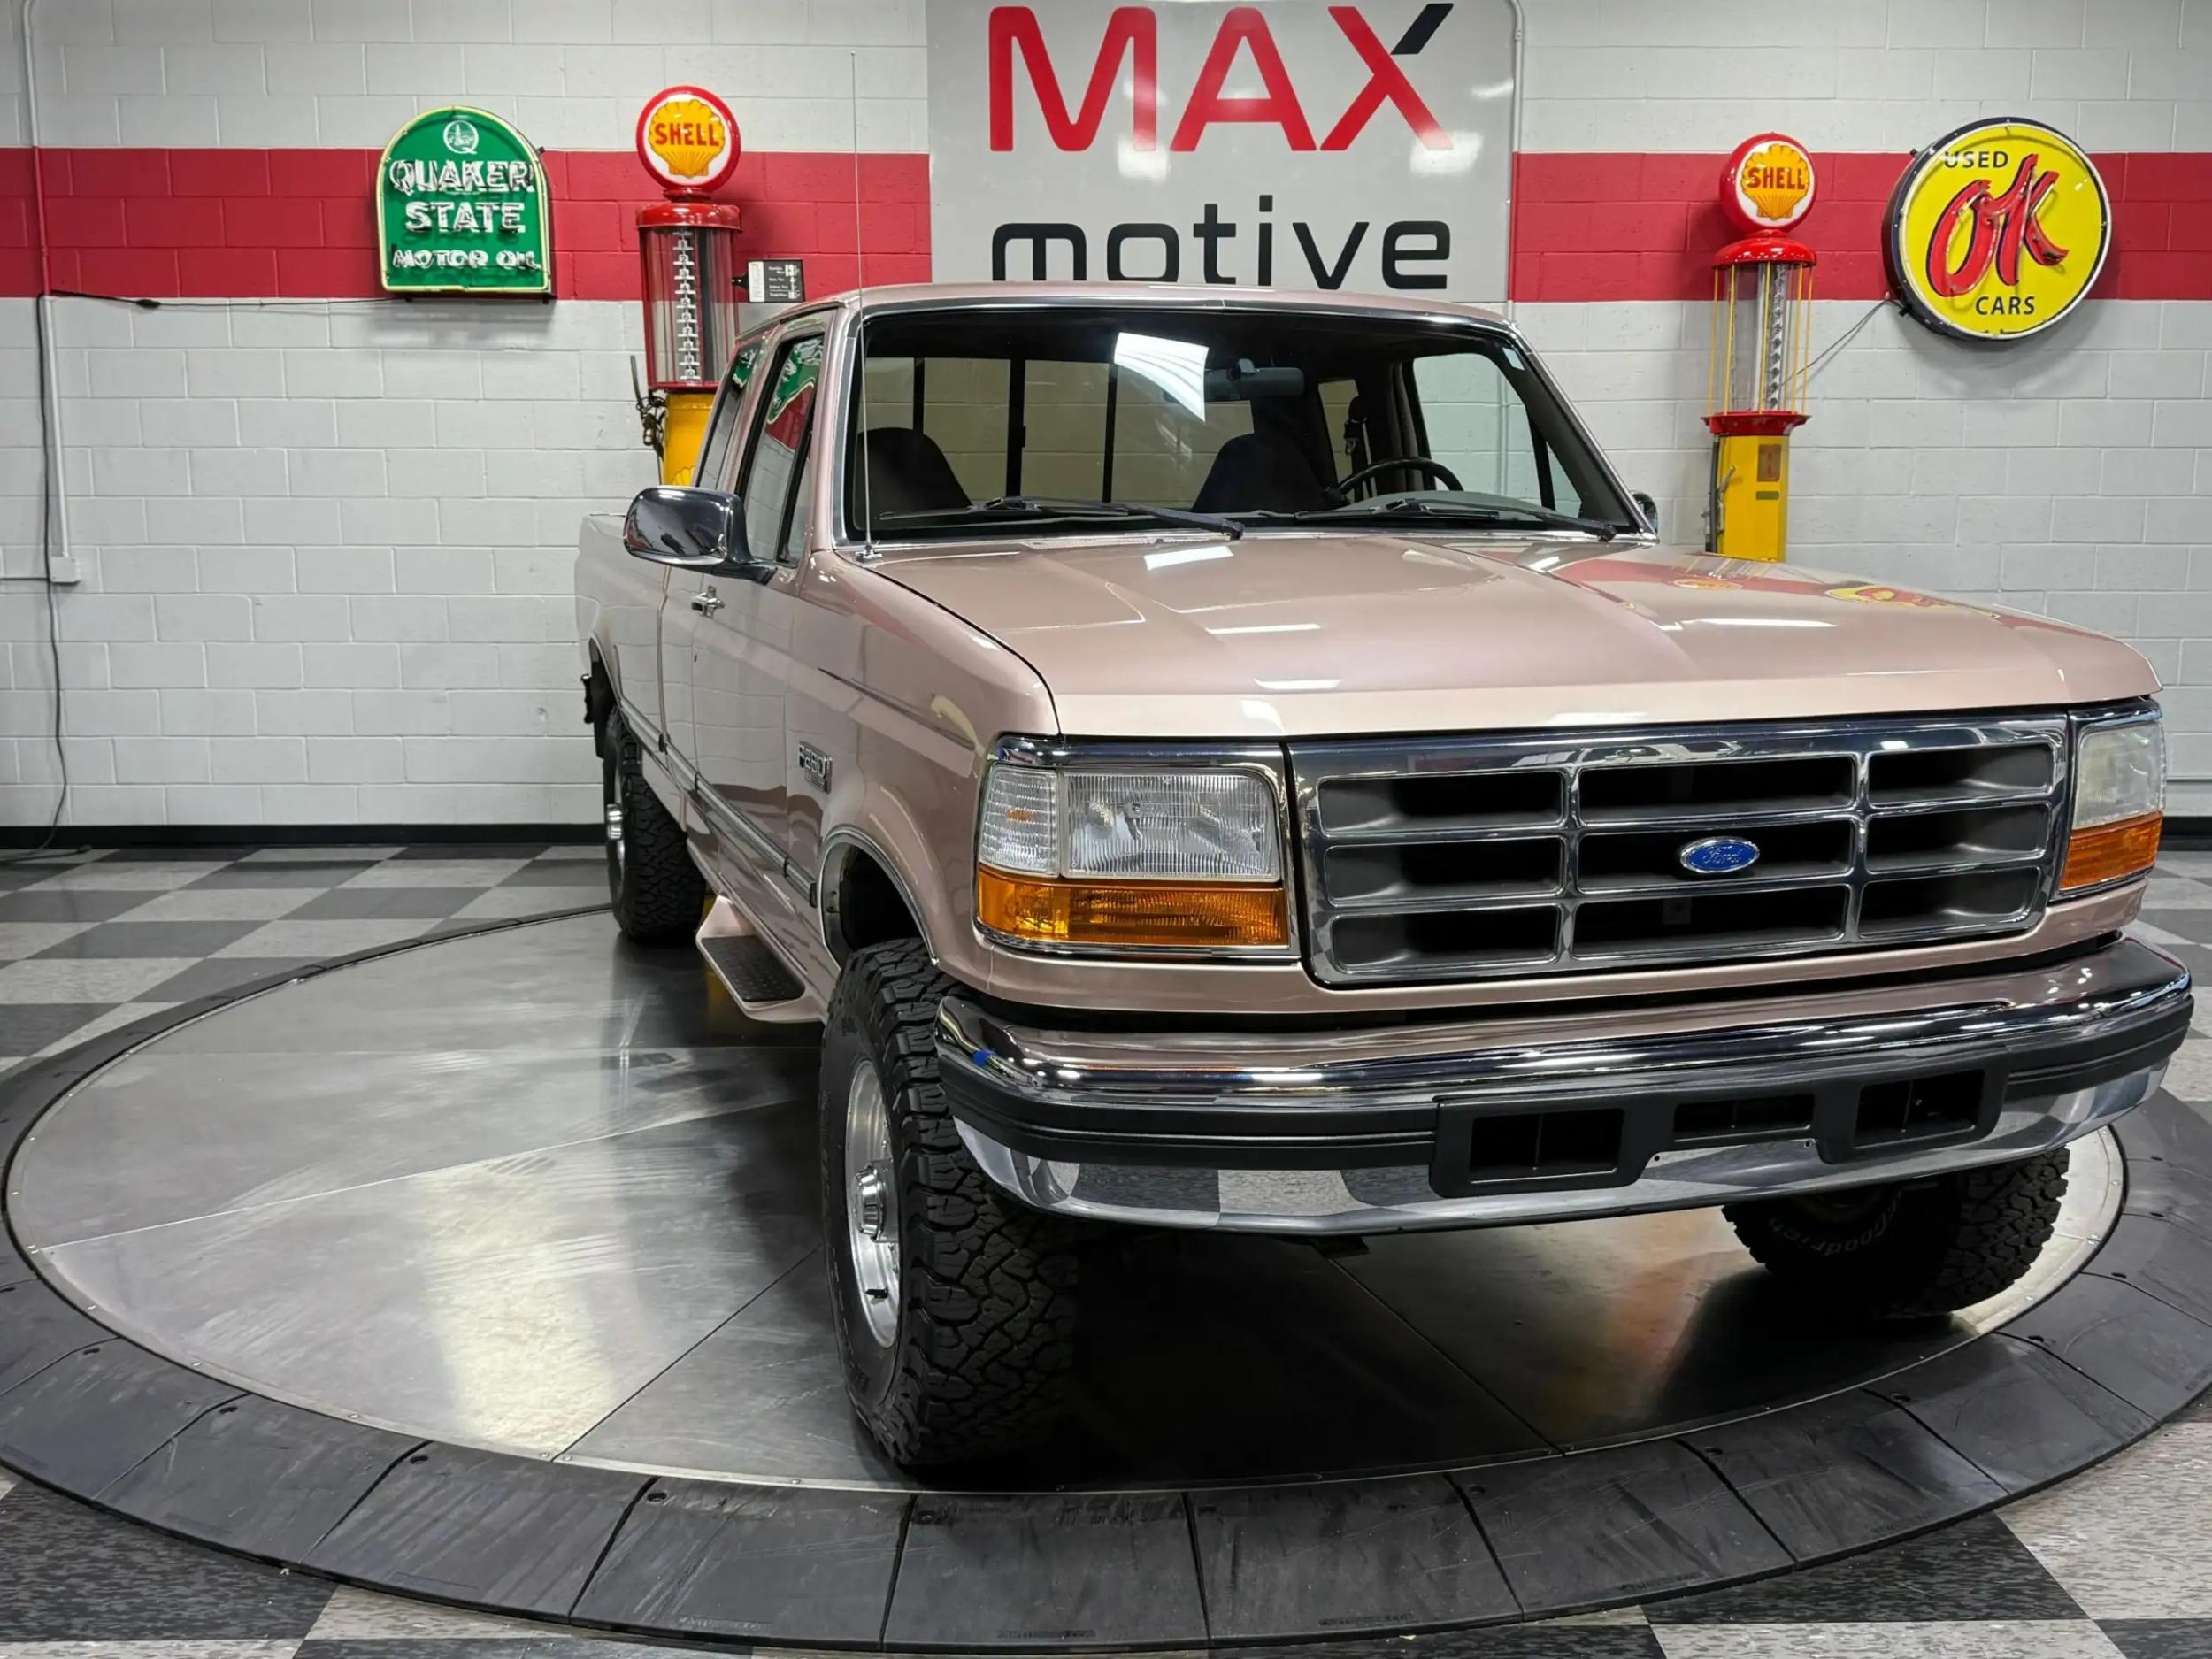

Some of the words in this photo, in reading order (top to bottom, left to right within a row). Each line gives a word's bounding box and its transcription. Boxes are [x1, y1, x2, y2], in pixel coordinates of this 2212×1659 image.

[988, 3, 1455, 152] MAX
[654, 122, 720, 147] SHELL
[1944, 150, 2009, 169] USED
[389, 158, 535, 196] QUAKER
[1746, 166, 1806, 190] SHELL
[404, 200, 526, 234] STATE
[1925, 153, 2070, 298] OK
[991, 194, 1452, 291] motive
[392, 249, 489, 269] MOTOR
[495, 250, 542, 270] OIL
[1975, 296, 2036, 315] CARS
[1701, 845, 1743, 864] Ford
[1768, 1189, 1904, 1256] FGoodrich
